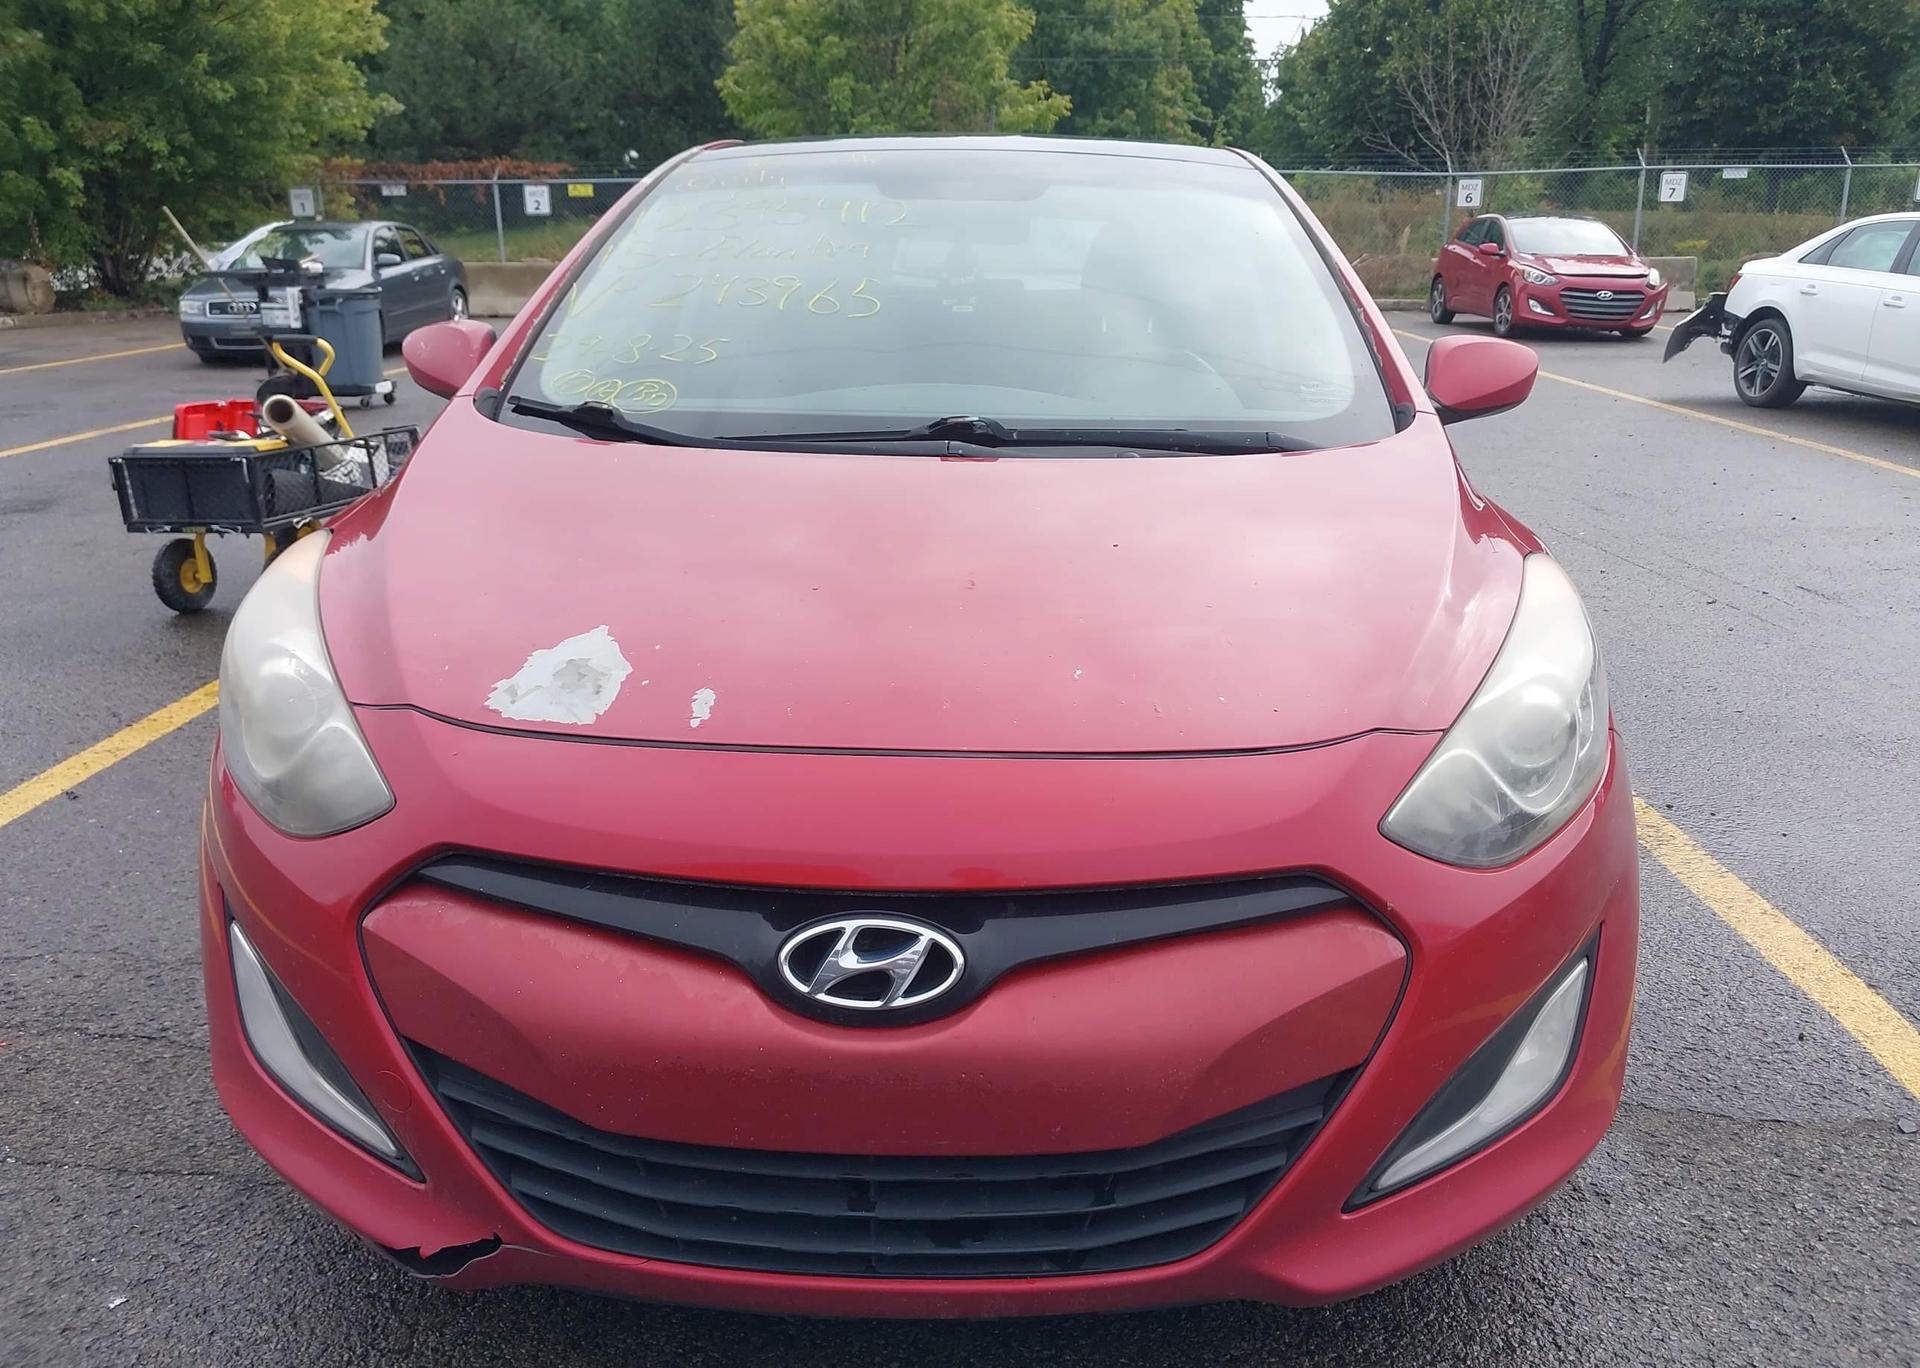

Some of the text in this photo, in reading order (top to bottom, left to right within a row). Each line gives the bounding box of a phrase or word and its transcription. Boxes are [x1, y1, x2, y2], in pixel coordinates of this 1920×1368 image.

[1461, 183, 1479, 192] MDZ
[1668, 187, 1676, 198] 7
[1465, 192, 1473, 204] 6
[534, 199, 541, 210] 2
